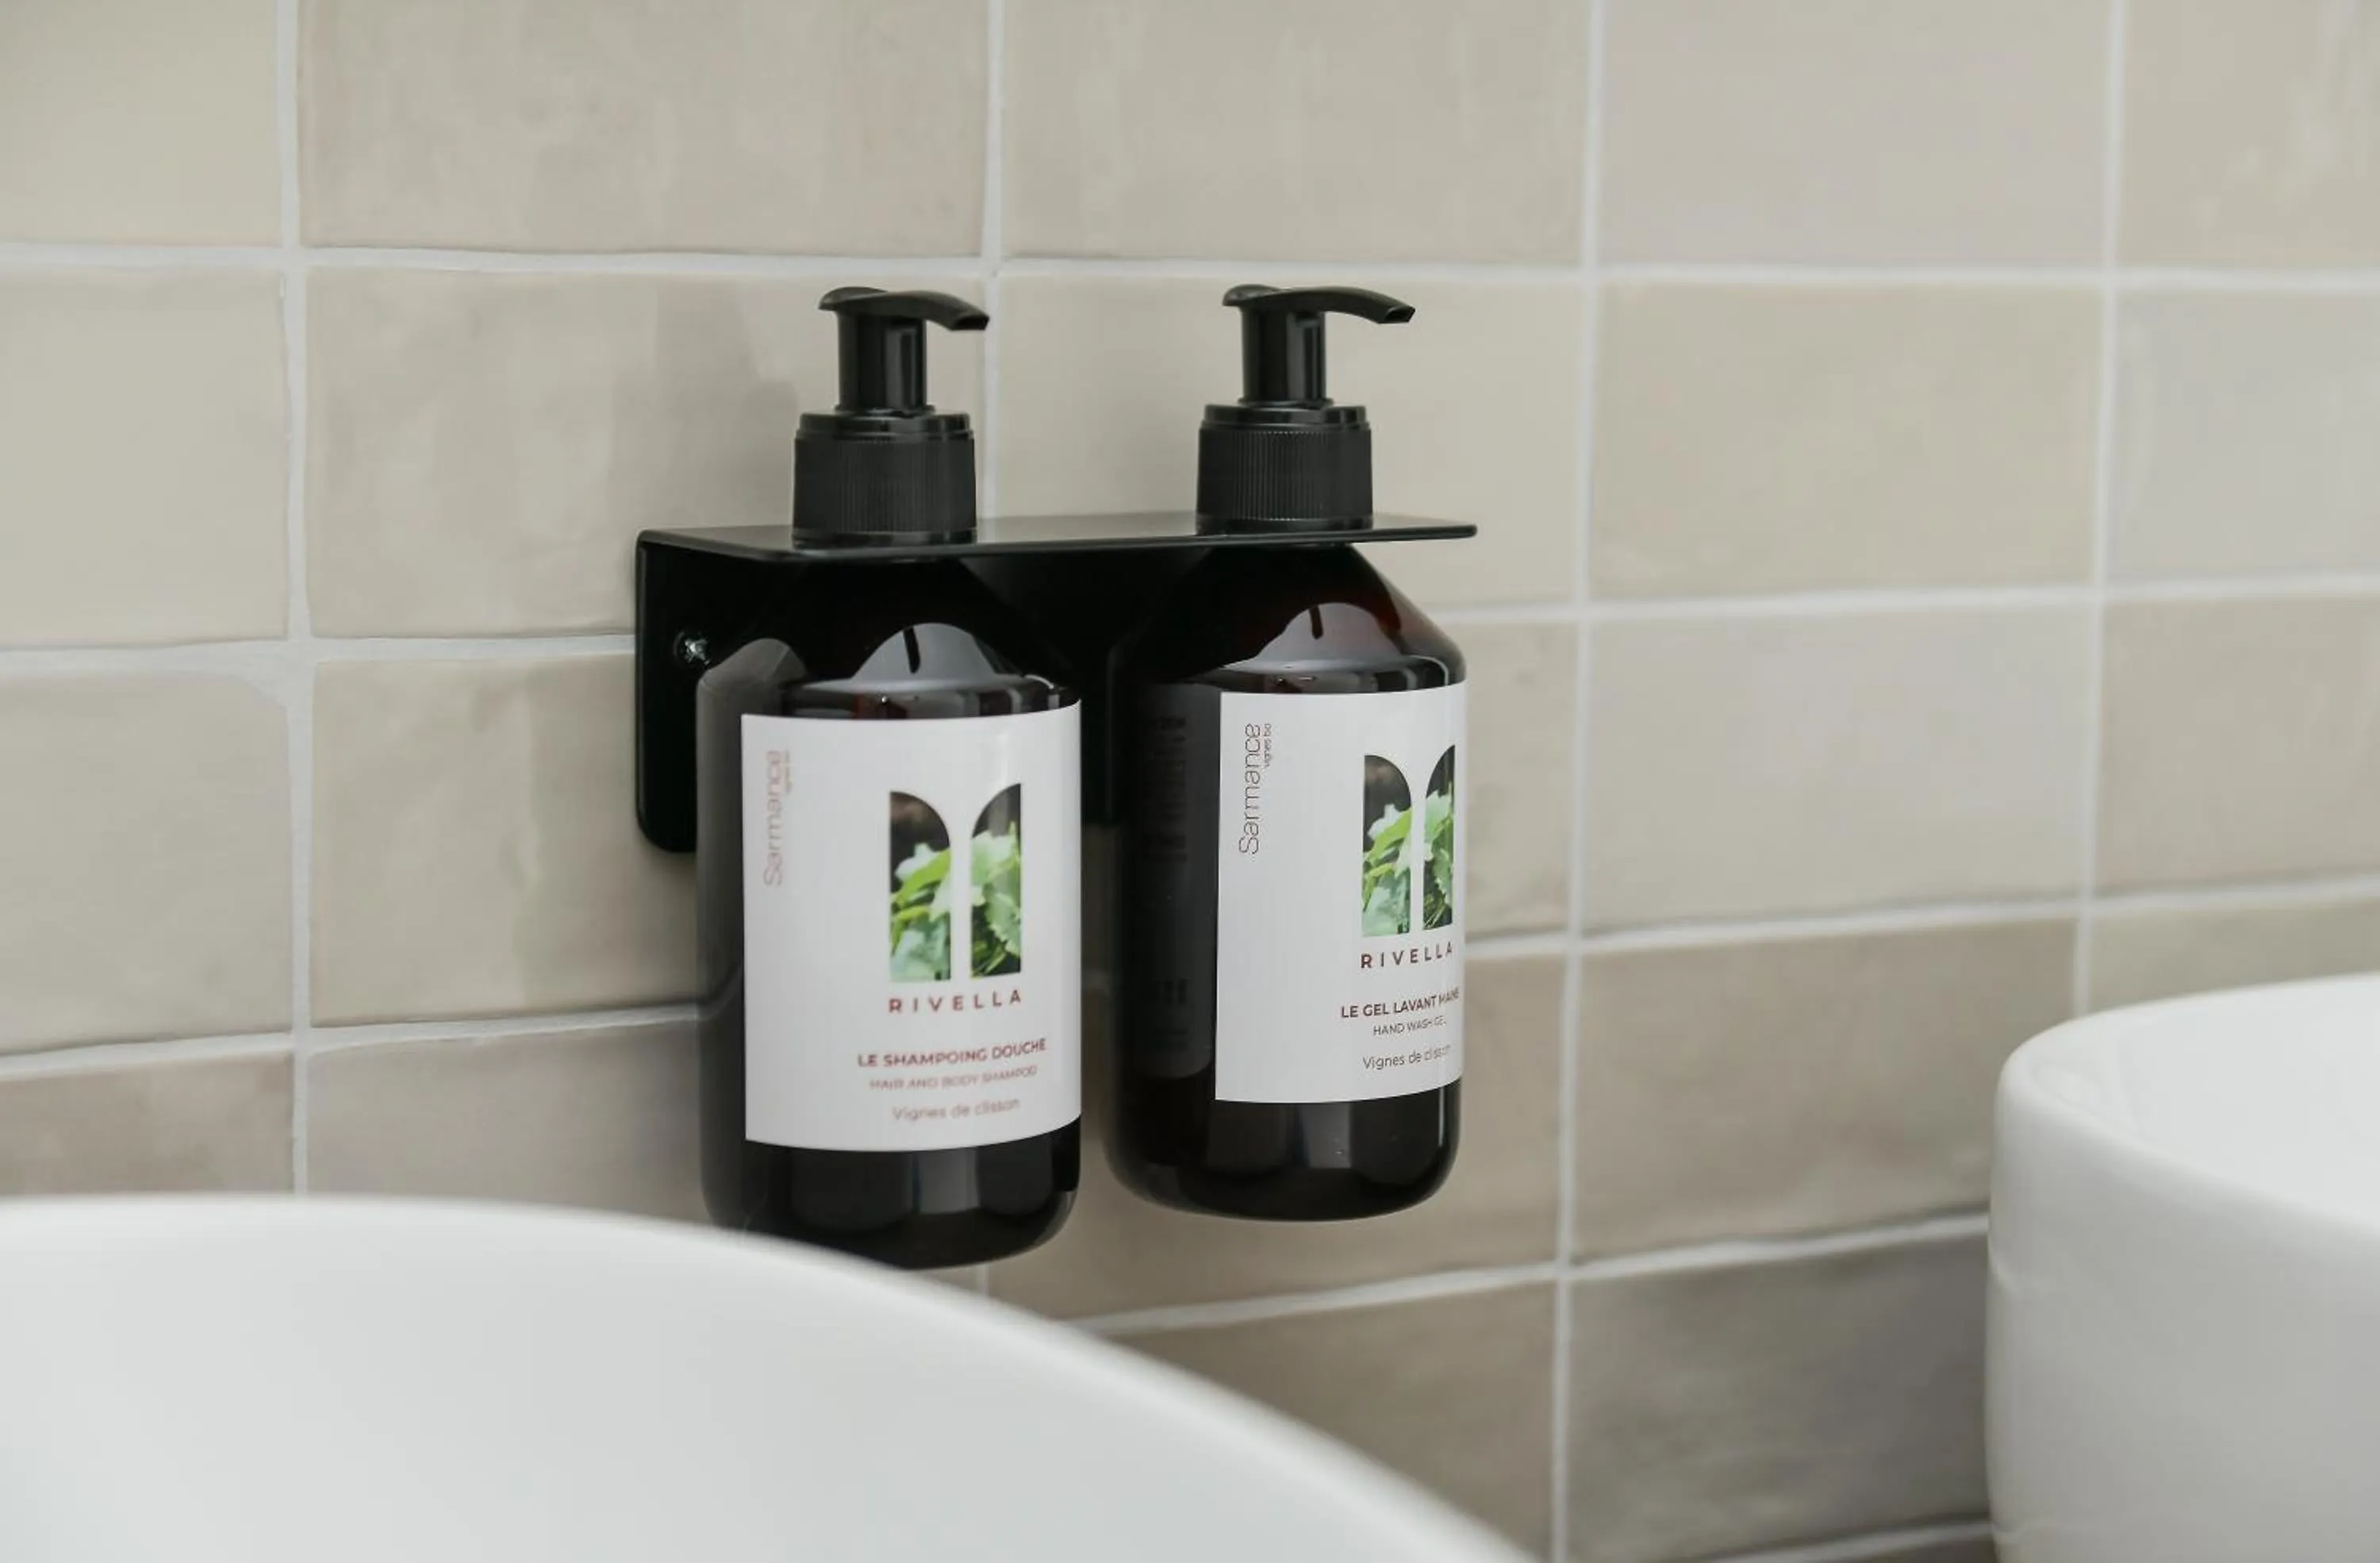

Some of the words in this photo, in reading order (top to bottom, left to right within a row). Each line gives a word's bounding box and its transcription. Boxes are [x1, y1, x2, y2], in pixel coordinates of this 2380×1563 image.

[1238, 723, 1261, 854] Sarmance
[1360, 941, 1453, 969] RIVELLA
[889, 989, 1022, 1013] RIVELLA
[1341, 1005, 1358, 1019] LE
[1362, 1004, 1389, 1017] GEL
[1393, 995, 1437, 1014] LAVANT
[1373, 1023, 1404, 1036] HAND
[857, 1054, 877, 1067] LE
[883, 1048, 988, 1067] SHAMPOING
[992, 1038, 1047, 1060] DOUCHE
[1362, 1054, 1405, 1071] Vignes
[1408, 1049, 1422, 1064] de
[942, 1073, 979, 1089] BODY
[950, 1103, 970, 1117] de
